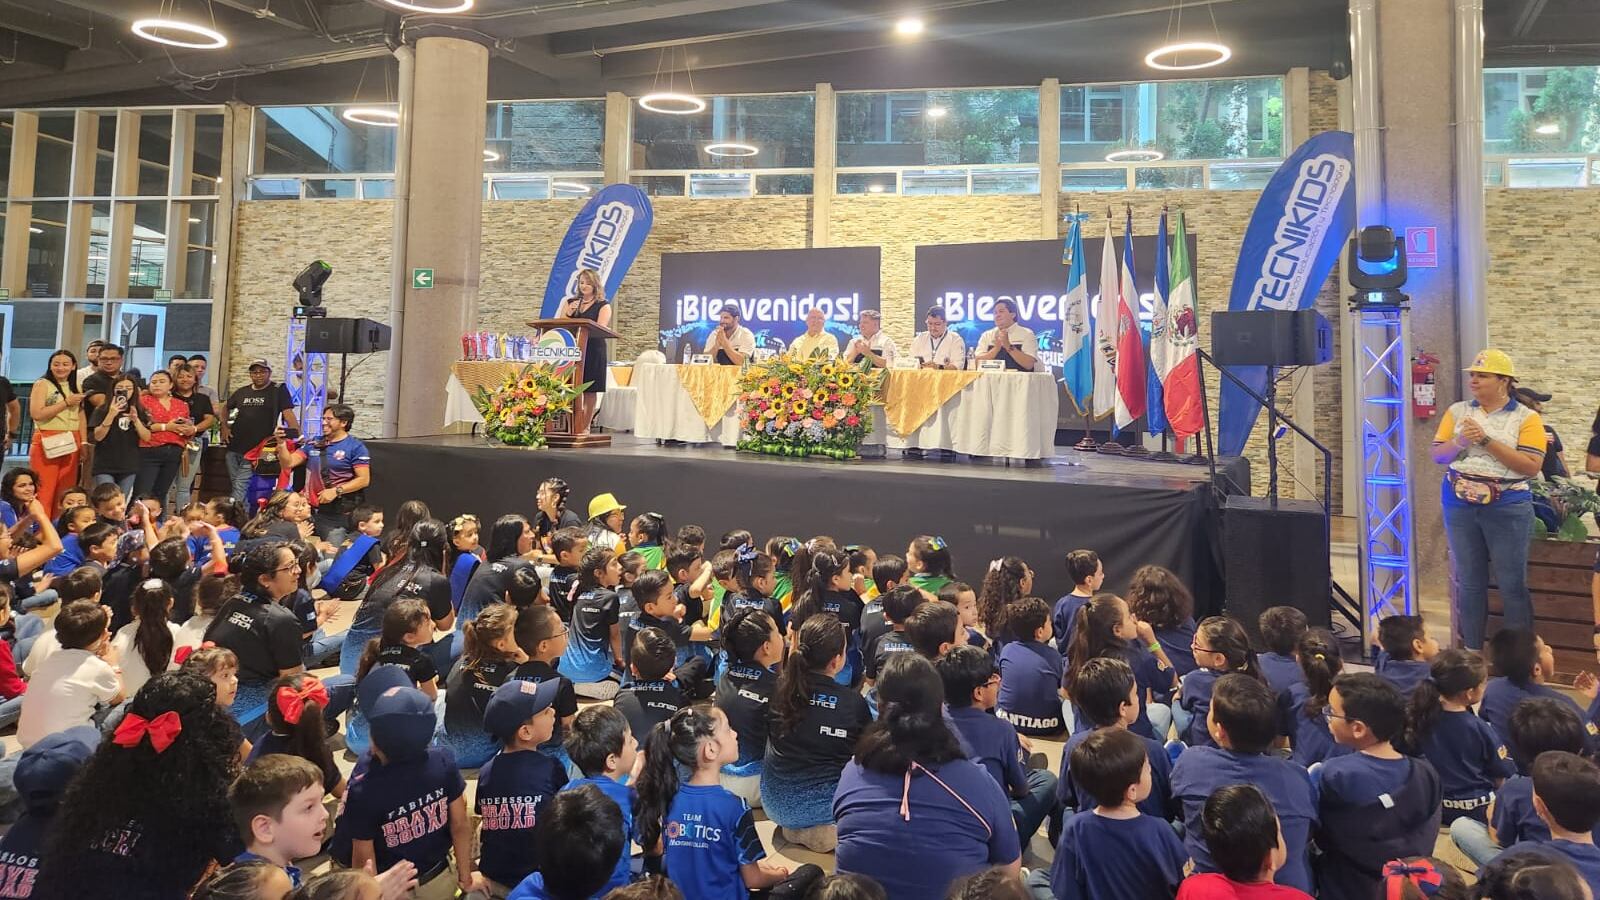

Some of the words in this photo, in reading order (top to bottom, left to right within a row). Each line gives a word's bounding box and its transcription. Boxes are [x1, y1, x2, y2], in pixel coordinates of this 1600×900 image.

[1255, 160, 1335, 311] TECNIKIDS
[676, 293, 859, 325] ¡Bievenidos!
[532, 347, 581, 357] TECNIKIDS
[819, 725, 848, 738] RUBI
[382, 797, 448, 837] BRAVE
[388, 788, 444, 819] FABIAN
[683, 813, 702, 821] TEAM
[386, 810, 448, 848] SQUAD
